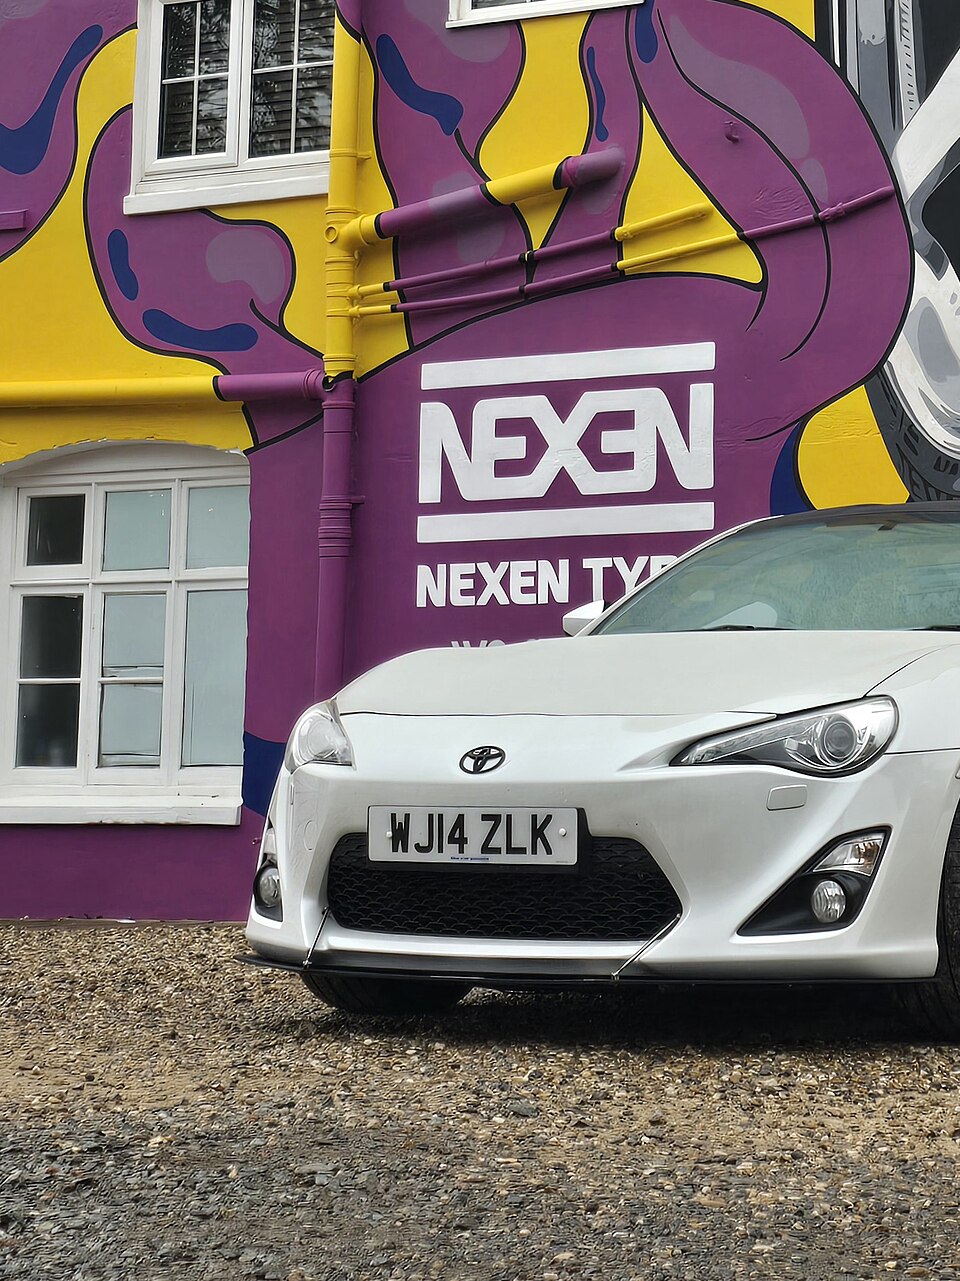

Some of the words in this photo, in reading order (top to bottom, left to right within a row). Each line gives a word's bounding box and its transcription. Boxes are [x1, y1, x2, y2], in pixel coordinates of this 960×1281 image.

[418, 382, 714, 504] NEXEN
[416, 559, 569, 608] NEXEN
[390, 812, 468, 855] WJ14
[480, 813, 553, 856] ZLK
